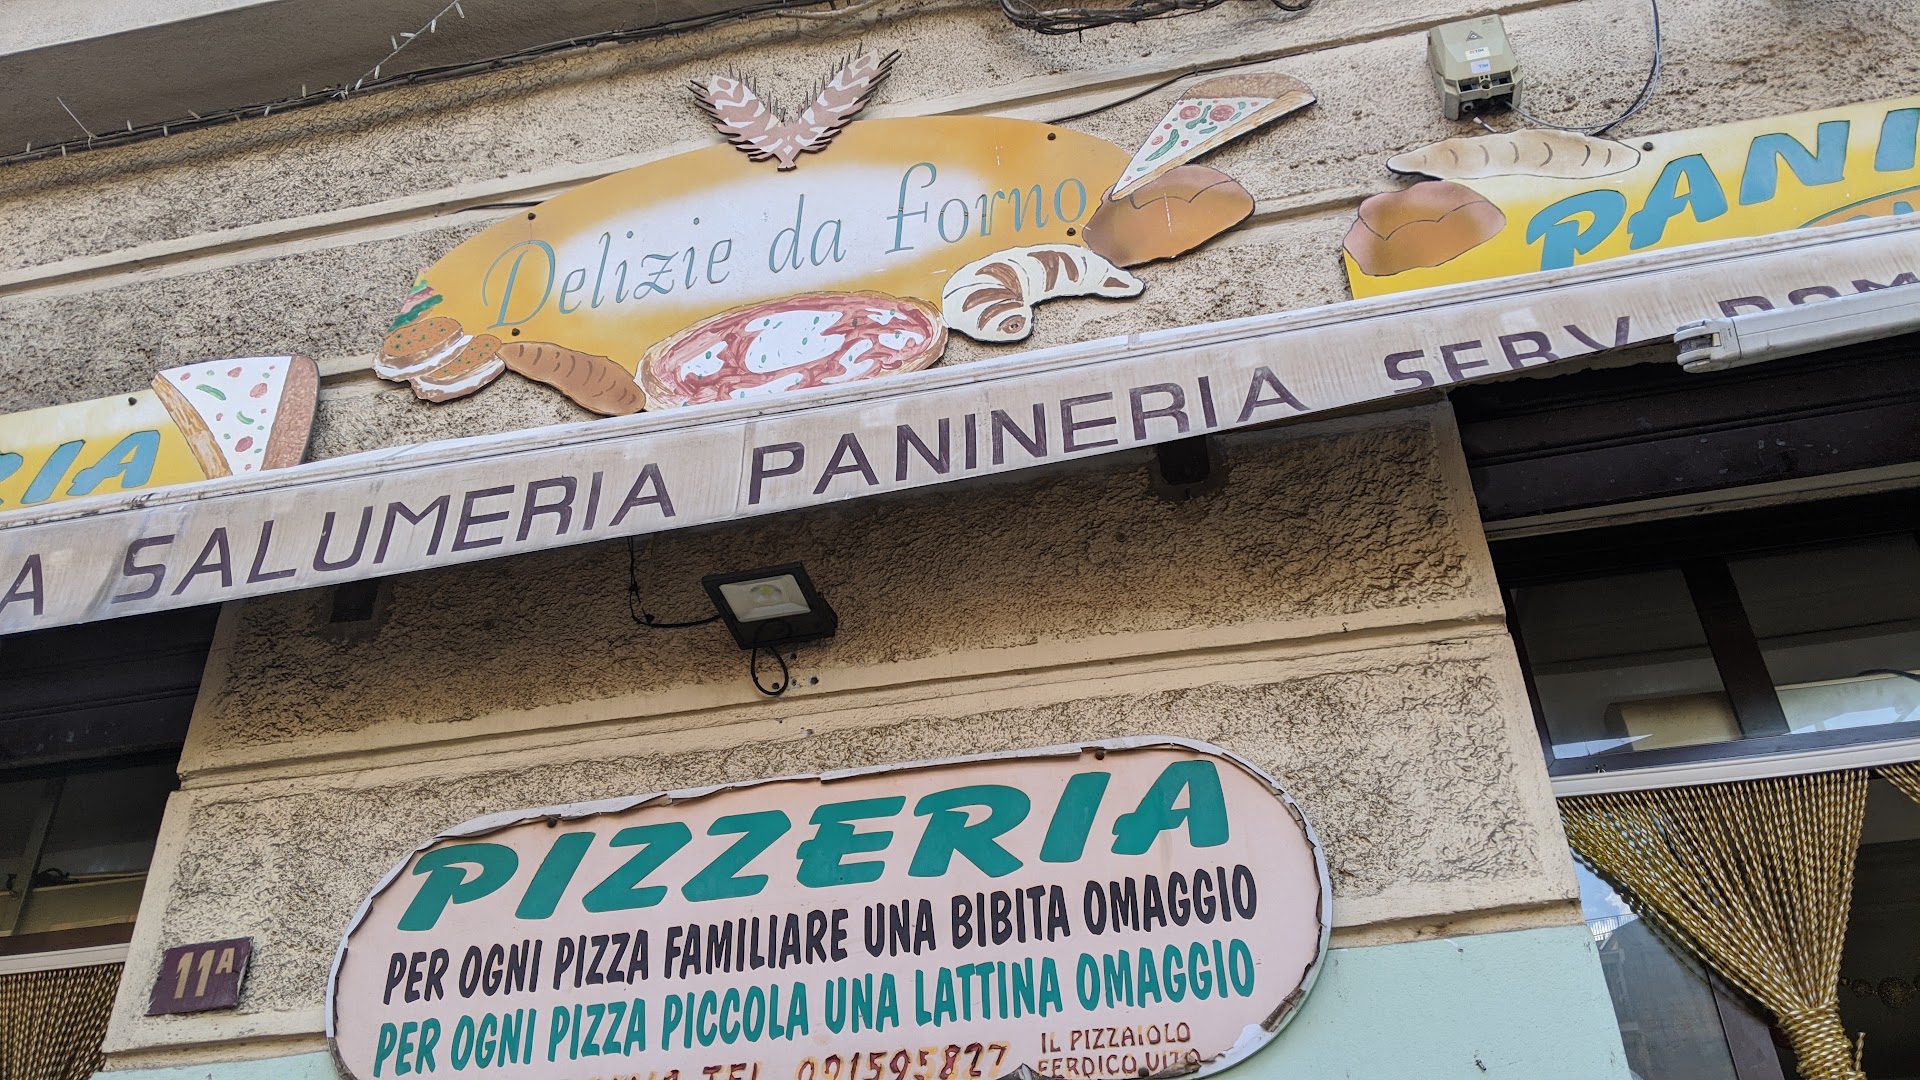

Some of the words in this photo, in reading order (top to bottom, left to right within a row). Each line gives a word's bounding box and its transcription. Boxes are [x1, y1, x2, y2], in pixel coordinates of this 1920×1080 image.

[480, 216, 733, 329] Delizie
[768, 193, 847, 274] da
[111, 461, 676, 604] SALUMERIA
[747, 365, 1310, 505] PANINERIA
[398, 759, 1229, 931] PIZZERIA
[173, 947, 236, 999] 11A
[383, 949, 449, 1006] PER
[458, 936, 543, 999] OGNI
[552, 929, 649, 991] PIZZA
[664, 908, 849, 980] FAMILIARE
[864, 898, 936, 958] UNA
[951, 884, 1071, 950] BIBITA
[1083, 864, 1257, 936] OMAGGIO
[373, 1018, 441, 1077] PER
[450, 1003, 537, 1071] OGNI
[547, 998, 646, 1062] PIZZA
[661, 977, 809, 1051] PICCOLA
[825, 969, 898, 1034] UNA
[915, 957, 1063, 1026] LATTINA
[1076, 938, 1255, 1011] OMAGGIO
[1041, 1032, 1062, 1054] IL
[1071, 1022, 1191, 1051] PIZZAIOLO
